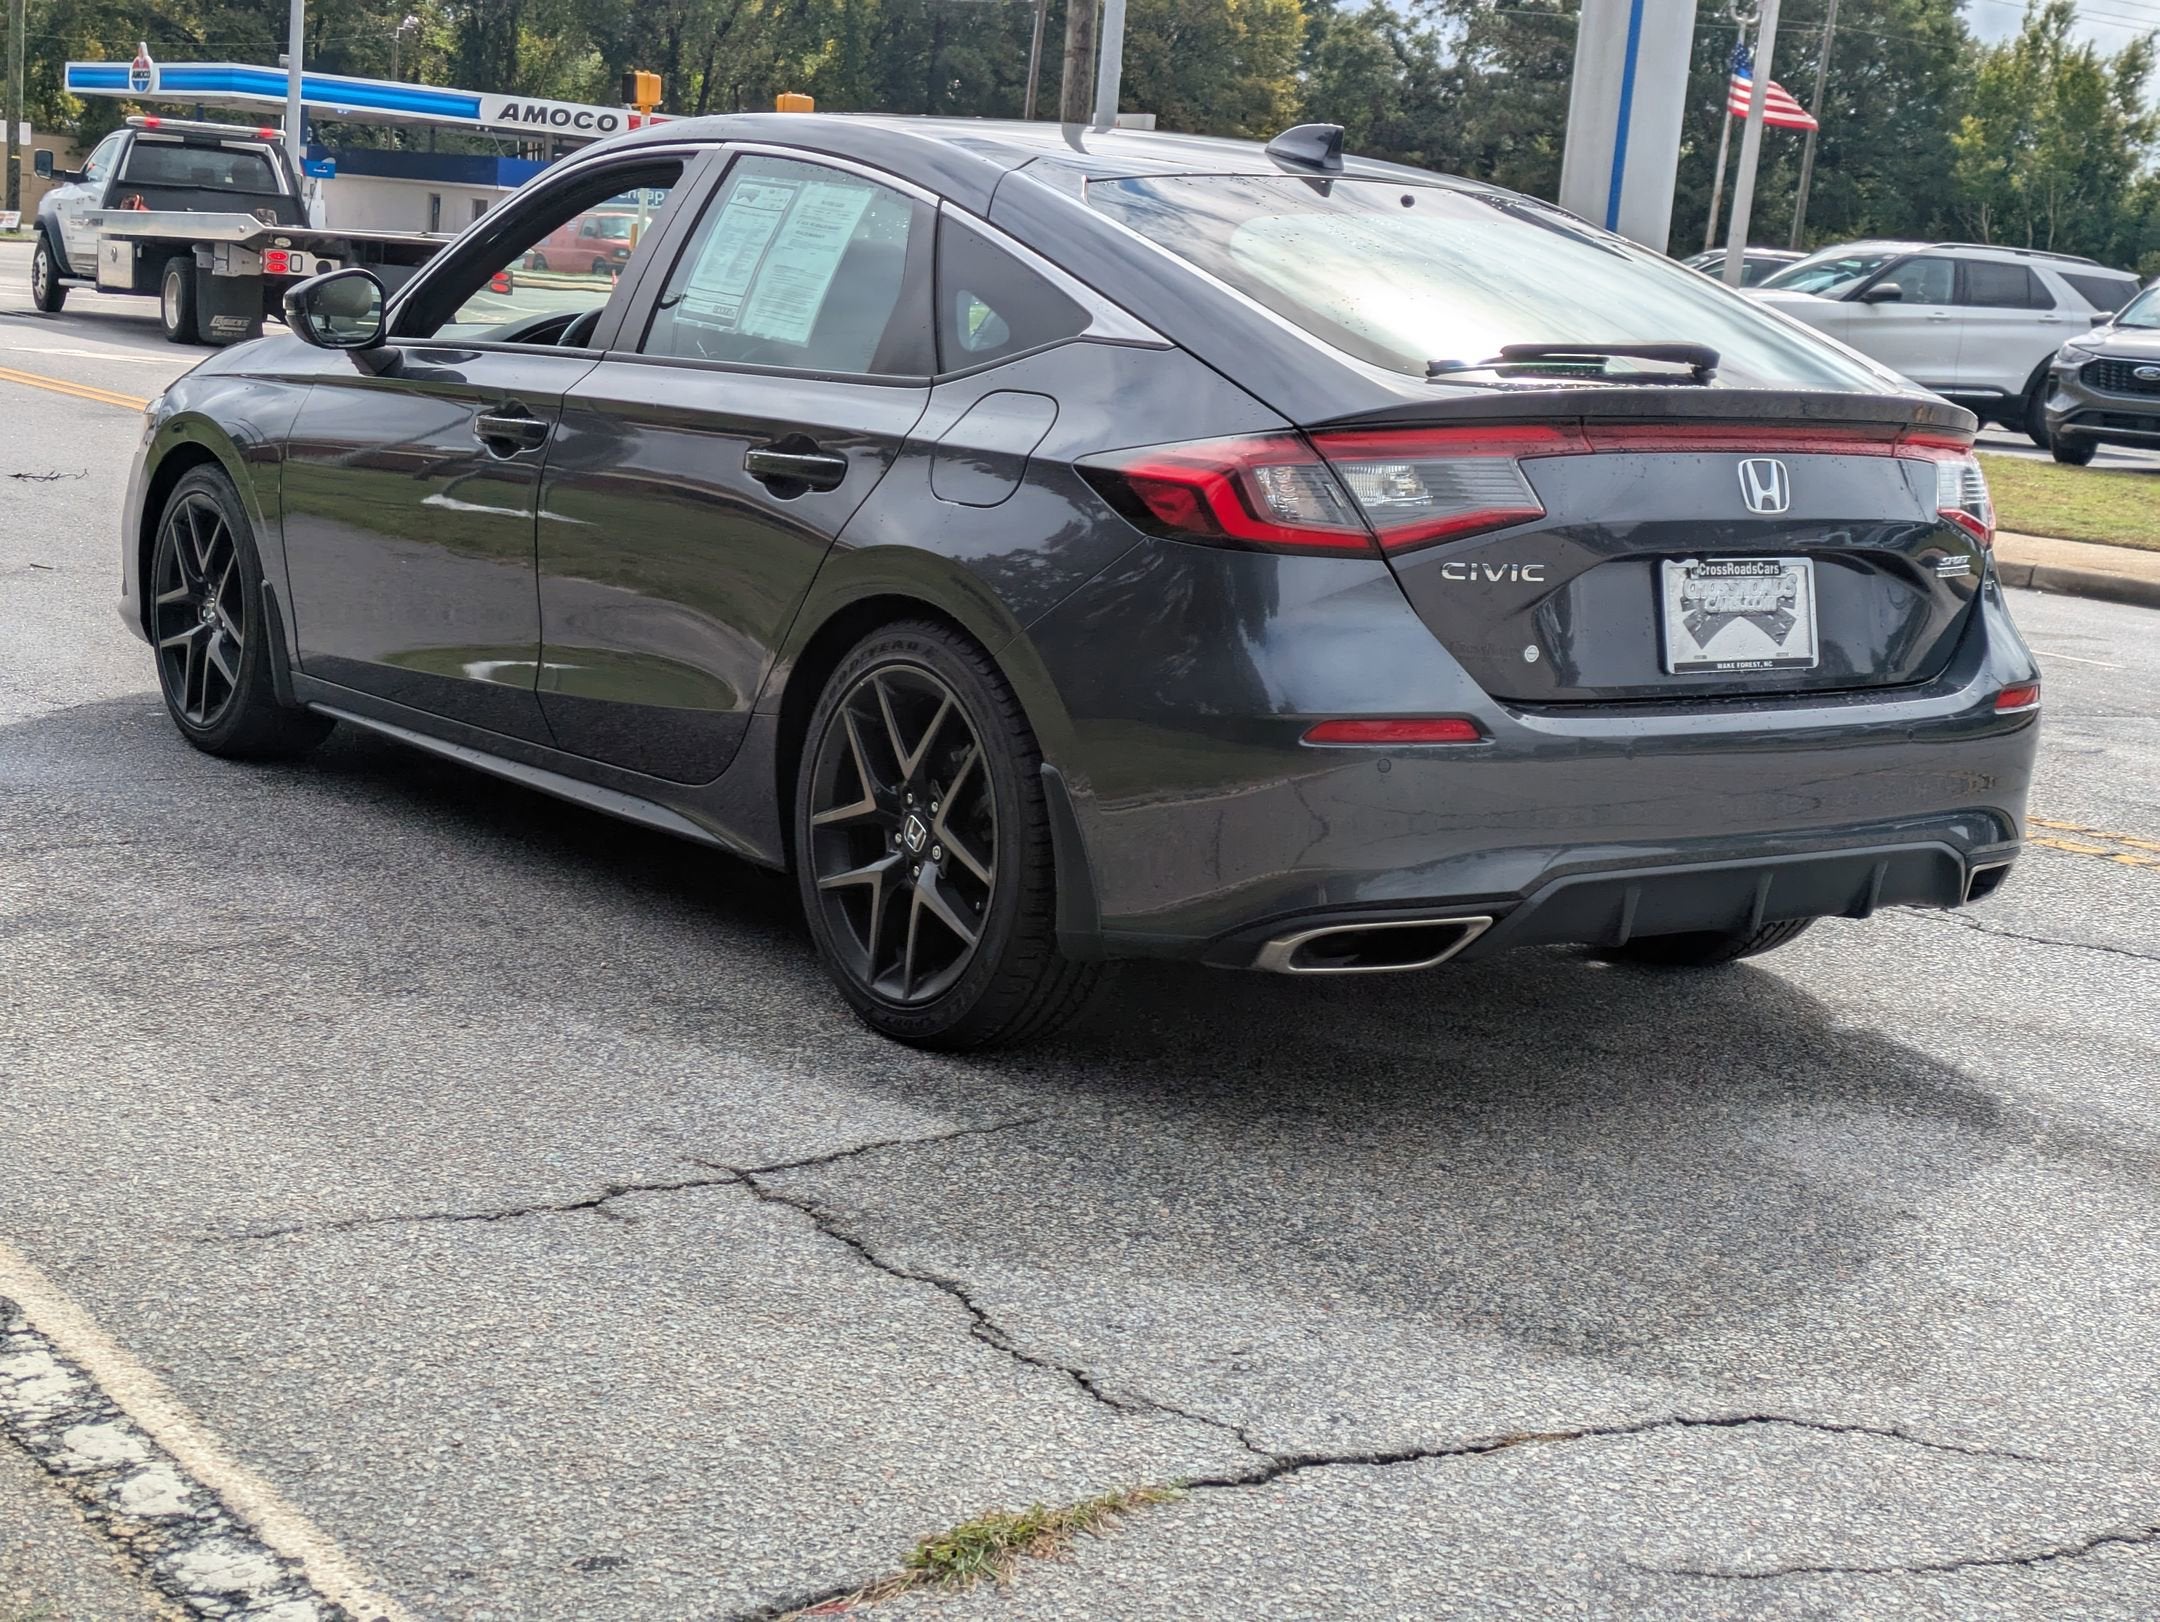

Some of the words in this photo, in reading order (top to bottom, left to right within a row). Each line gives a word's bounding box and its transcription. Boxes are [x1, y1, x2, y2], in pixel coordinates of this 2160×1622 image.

[498, 103, 619, 132] AMOCO
[1441, 562, 1545, 582] CIVIC
[1699, 563, 1780, 576] CrossRoadsCars
